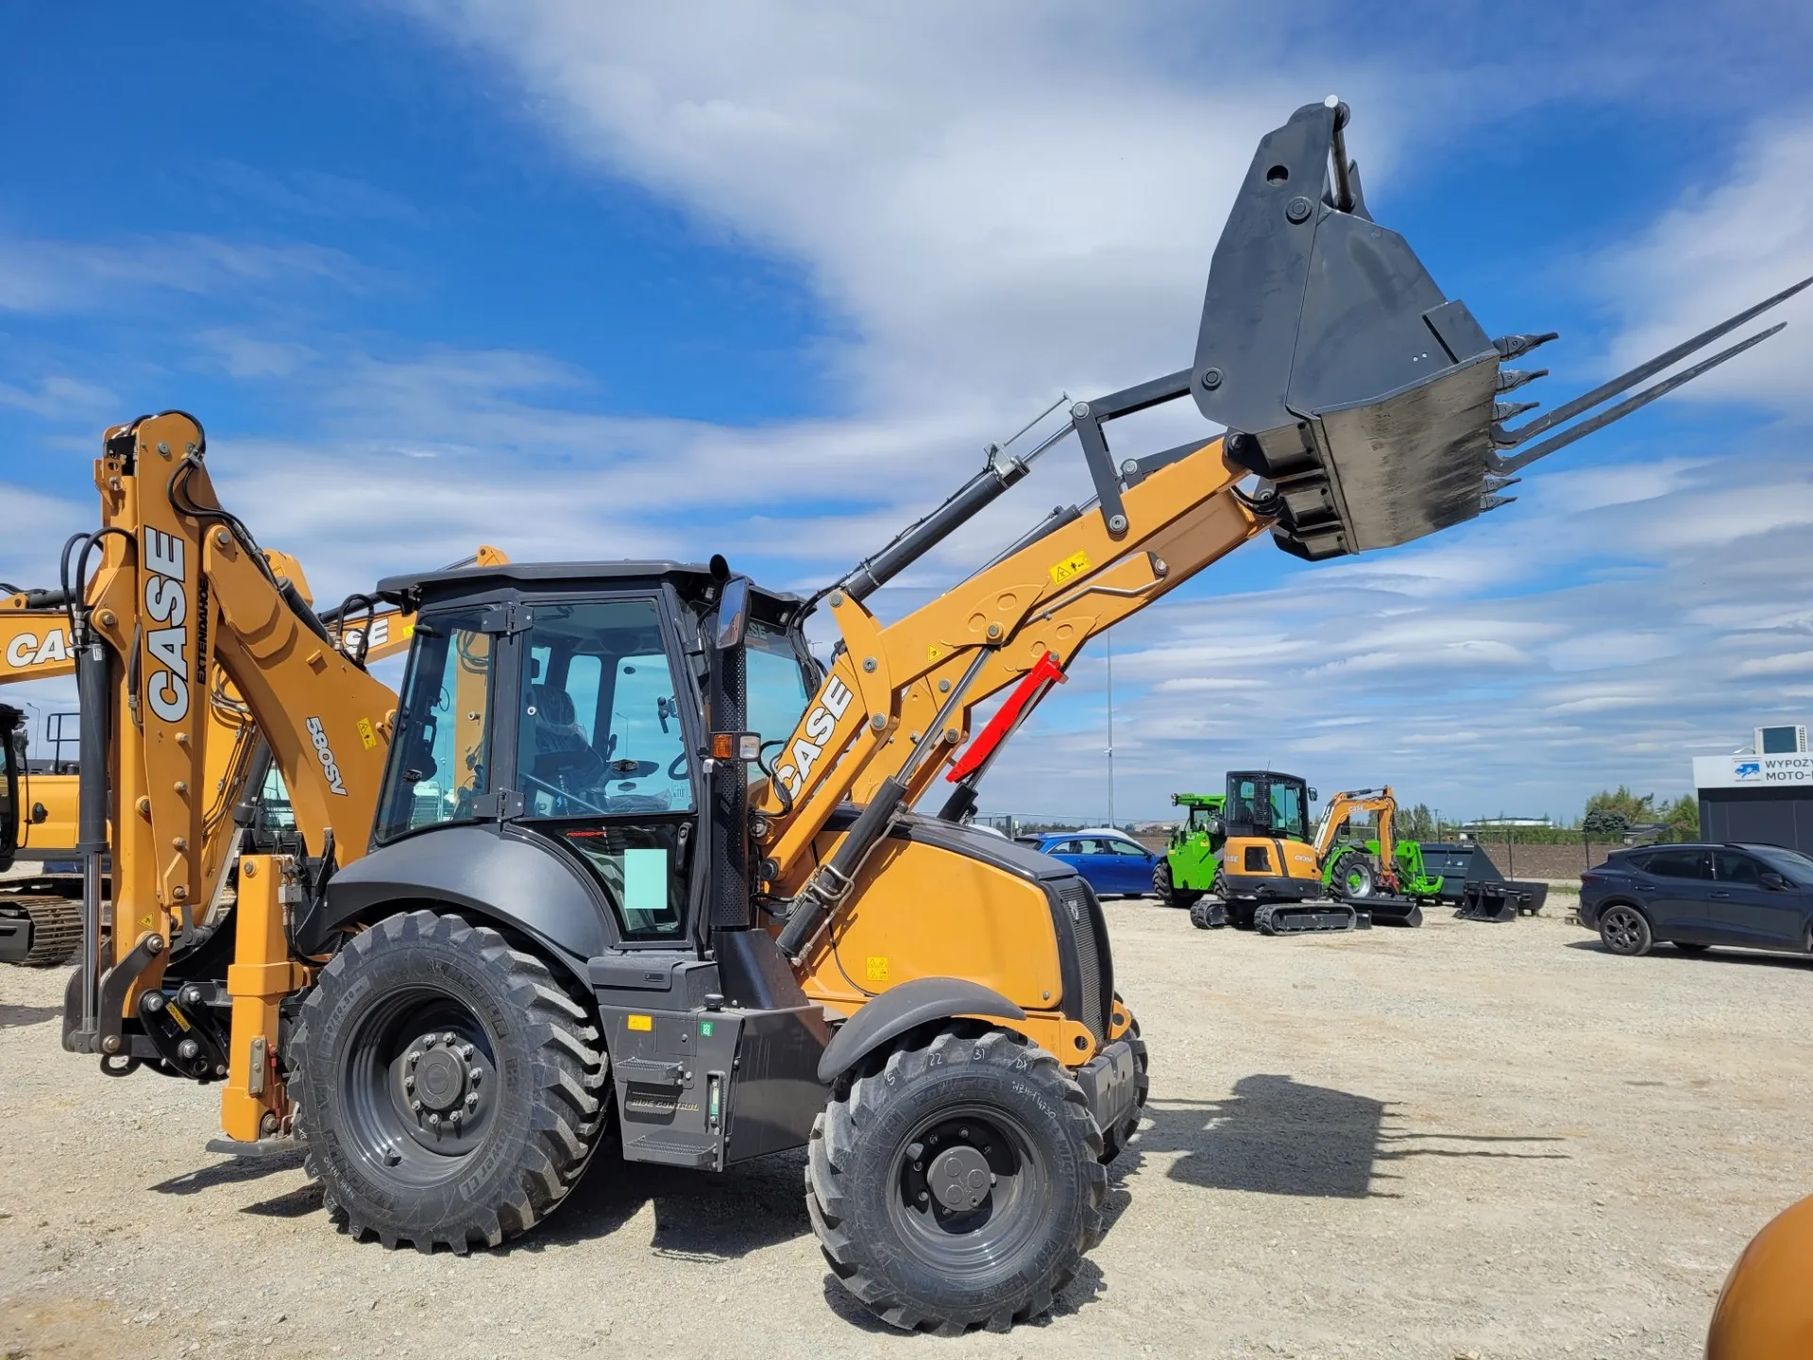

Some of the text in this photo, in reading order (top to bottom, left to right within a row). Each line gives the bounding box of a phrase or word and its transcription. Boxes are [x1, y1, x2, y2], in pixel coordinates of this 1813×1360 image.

[144, 525, 189, 723] CASE
[198, 575, 209, 686] EXTENDAHOE
[306, 716, 349, 796] 580SV
[774, 674, 854, 801] CASE
[1766, 771, 1813, 781] MOTO-
[928, 1053, 943, 1066] 22
[973, 1051, 985, 1061] 31
